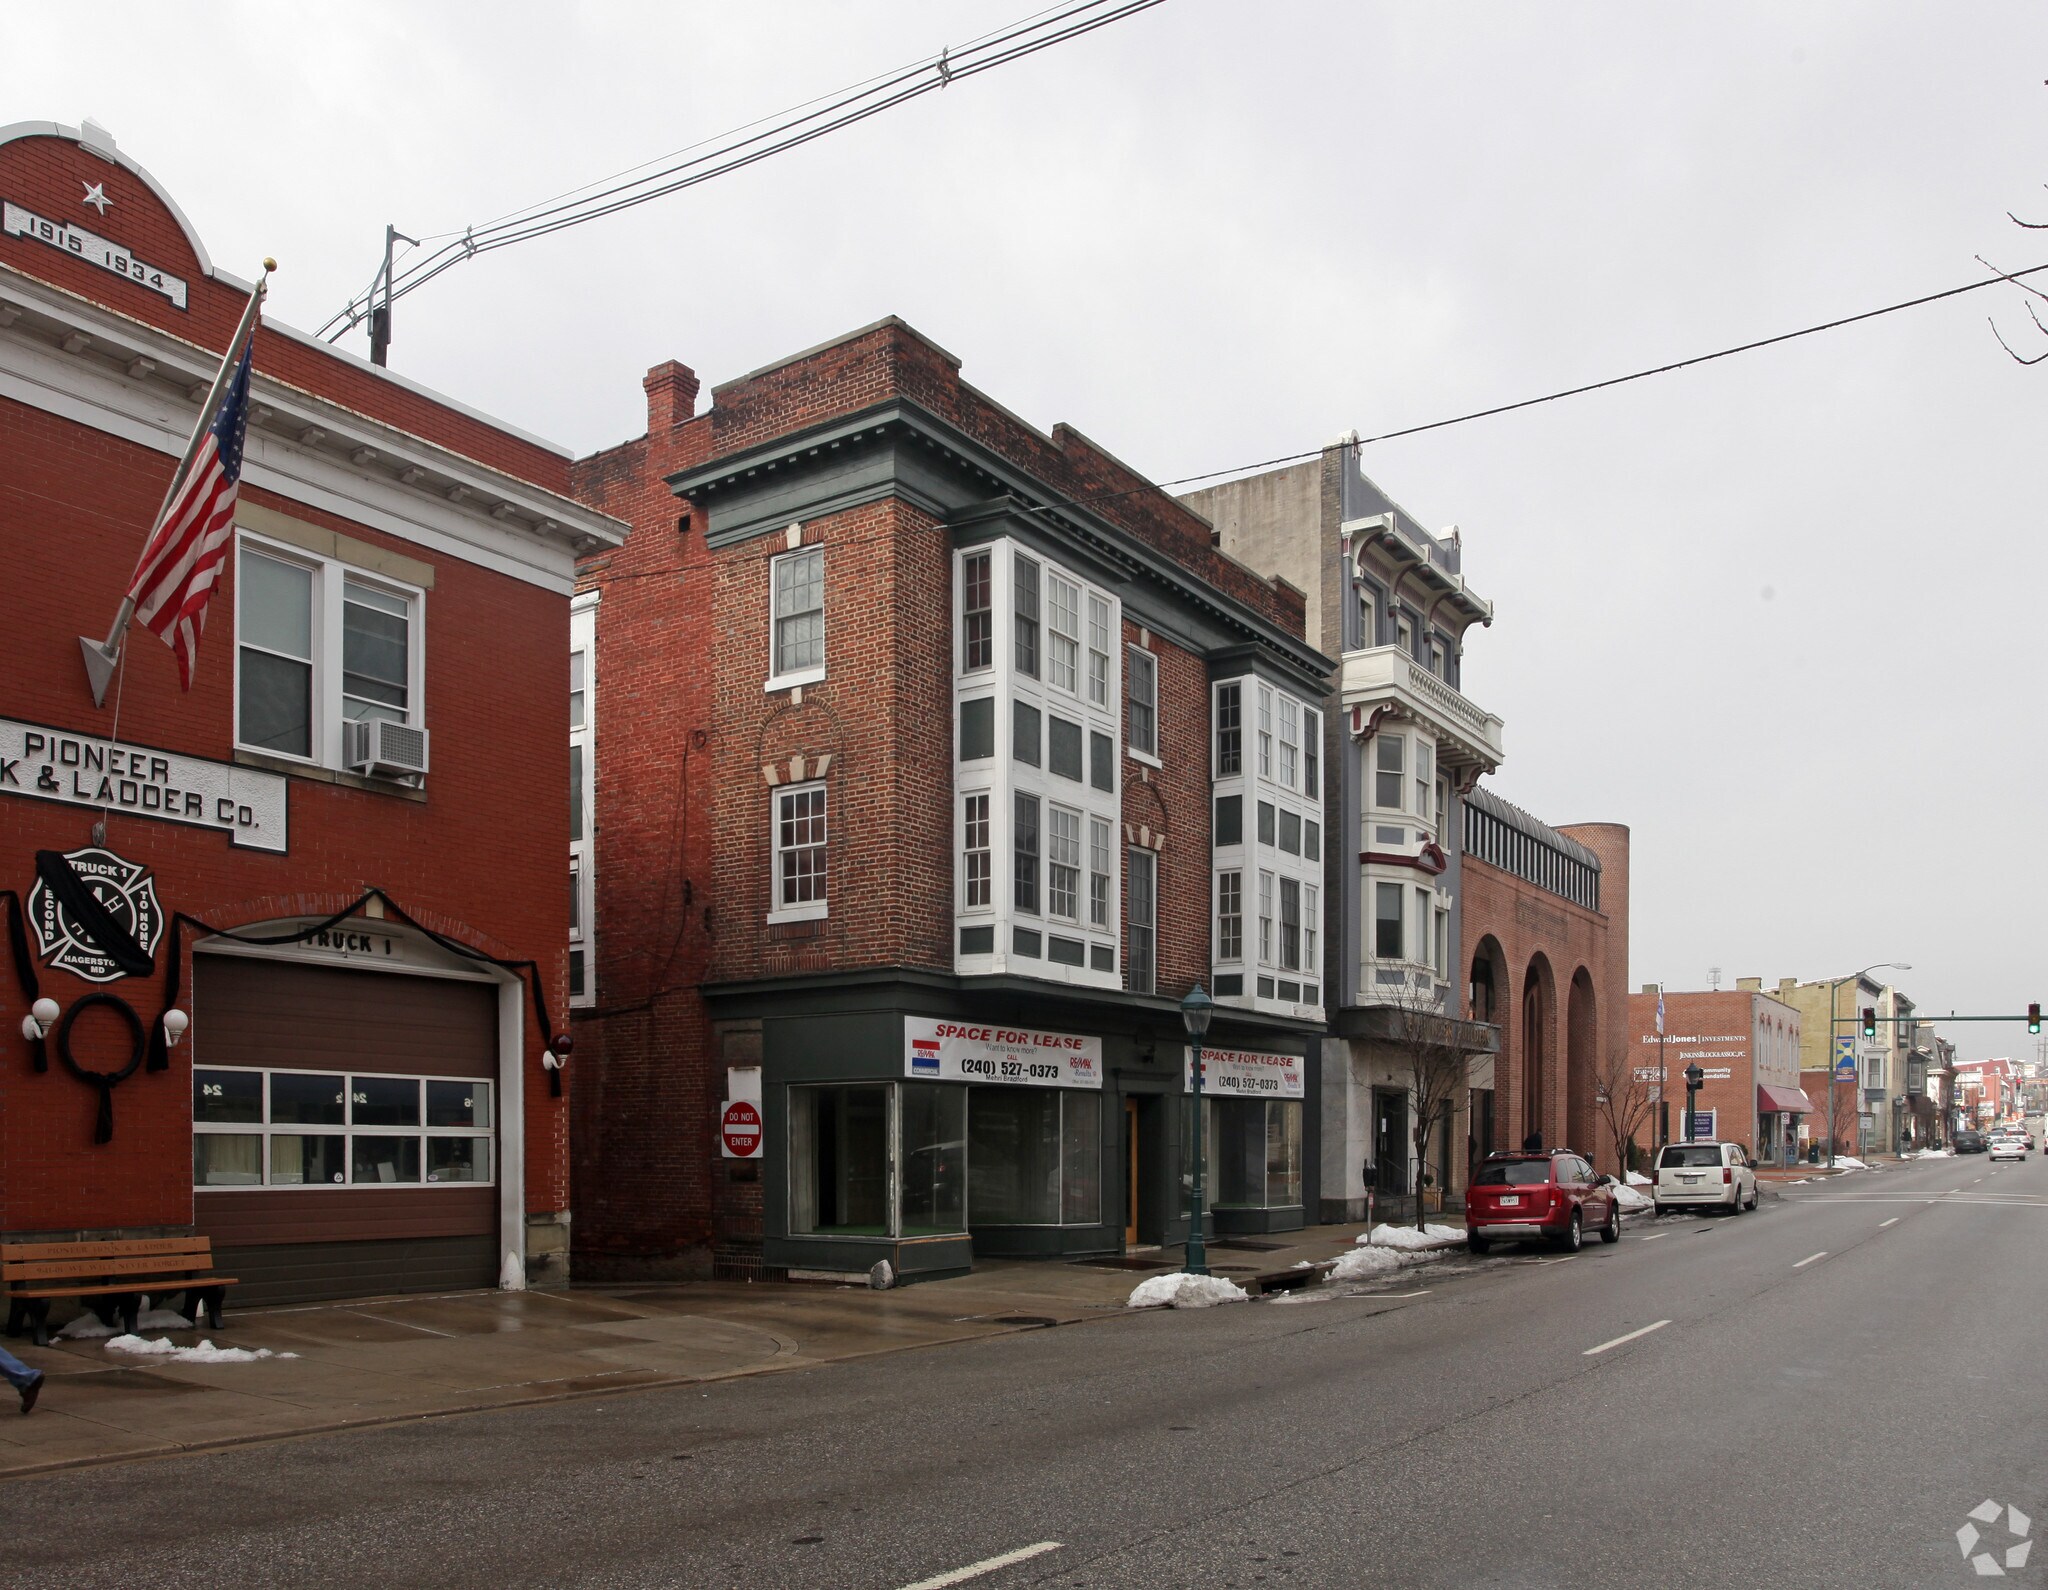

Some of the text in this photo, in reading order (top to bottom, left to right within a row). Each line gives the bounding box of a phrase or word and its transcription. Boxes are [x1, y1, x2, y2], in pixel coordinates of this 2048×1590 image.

[30, 217, 164, 289] 1915 1934
[25, 732, 169, 784] PIONEER
[37, 765, 60, 792] &
[73, 770, 203, 817] LADDER
[68, 860, 128, 877] TRUCK 1
[44, 888, 55, 940] ECOND
[140, 890, 149, 950] TO NONE
[90, 965, 106, 974] MD
[935, 1024, 1083, 1050] SPACE FOR LEASE
[1672, 1034, 1697, 1043] Jones
[917, 1049, 936, 1058] RE/MAX
[985, 1042, 1000, 1051] Want
[1007, 1045, 1020, 1053] know
[1021, 1047, 1038, 1055] more?
[1070, 1056, 1092, 1069] RE/MAX
[1201, 1049, 1294, 1067] SPACE FOR LEASE
[961, 1058, 1059, 1079] (240) 527-0373
[1003, 1075, 1029, 1083] Bradford
[1218, 1076, 1278, 1090] (240) 527-0373
[730, 1113, 754, 1121] DO NOT
[732, 1137, 752, 1146] ENTER
